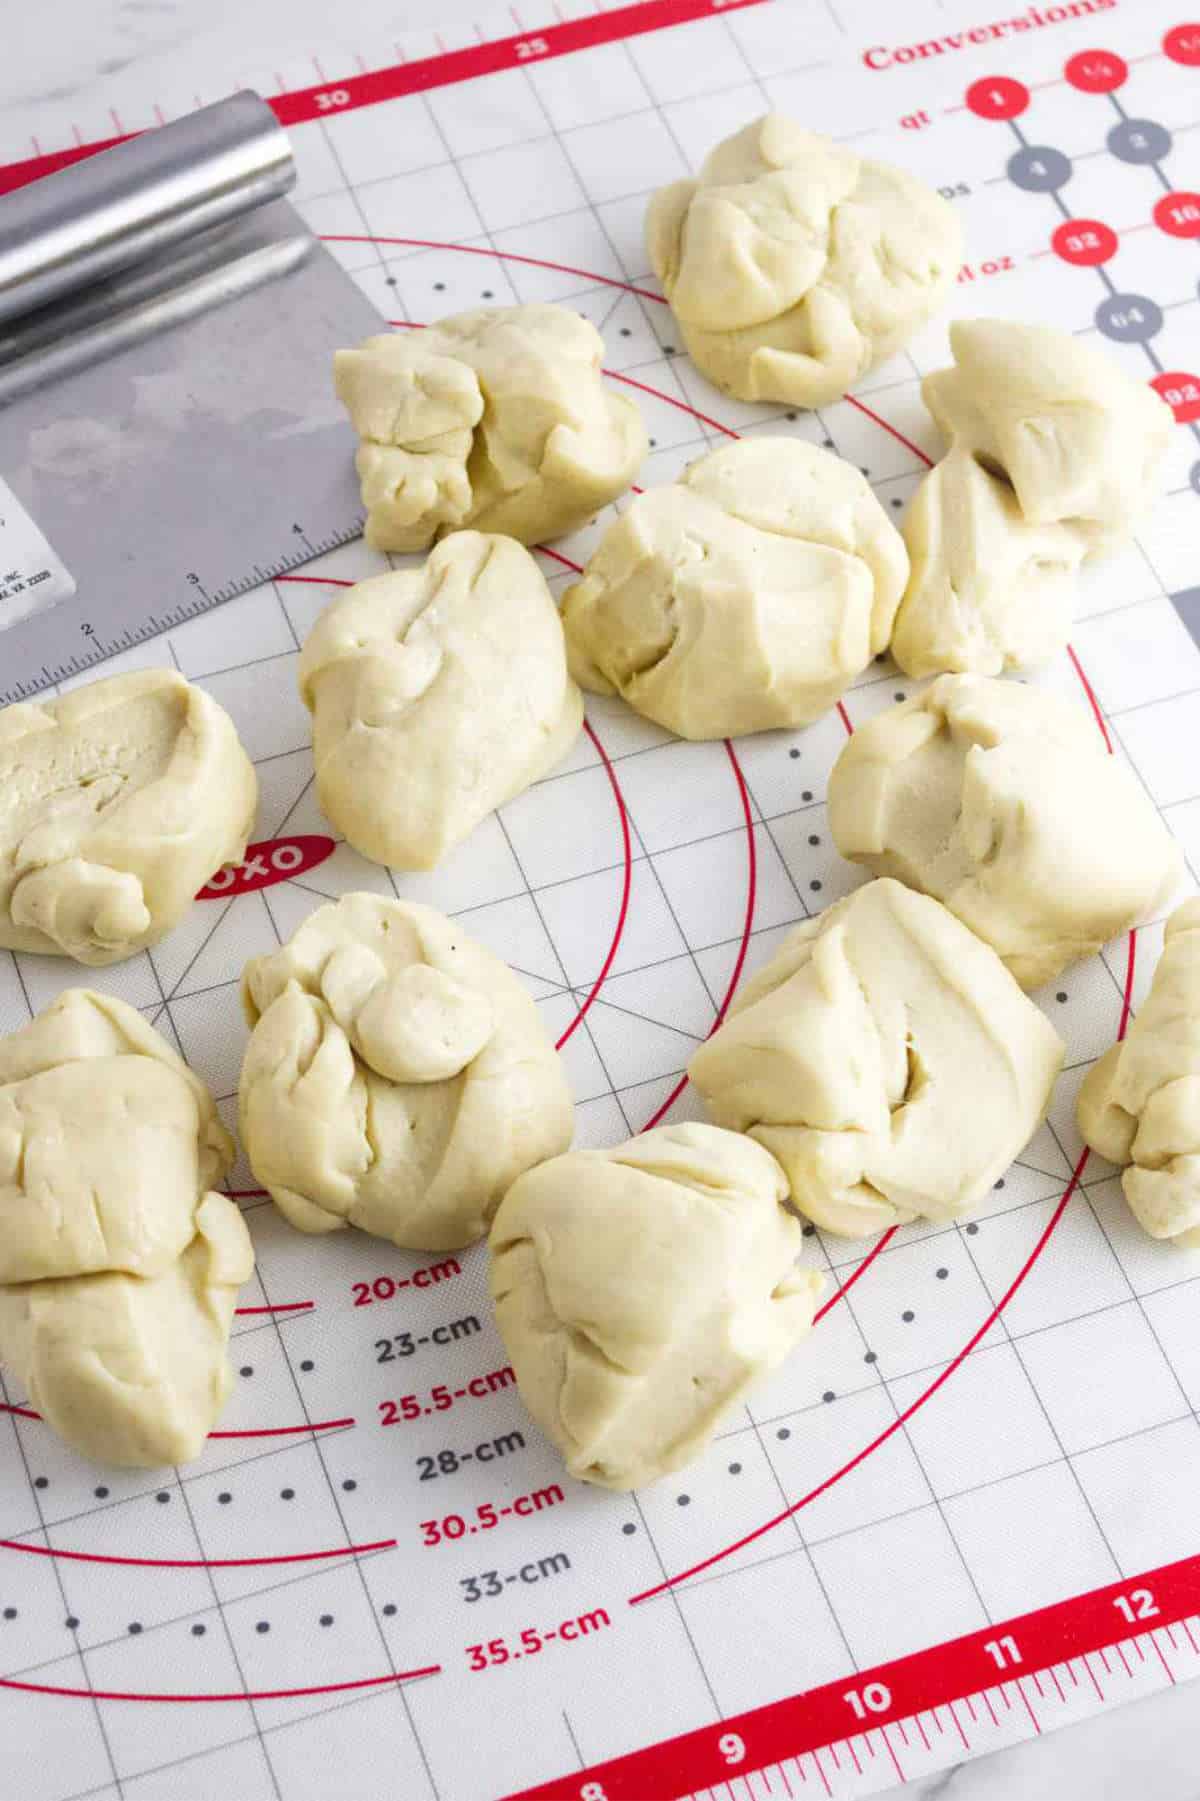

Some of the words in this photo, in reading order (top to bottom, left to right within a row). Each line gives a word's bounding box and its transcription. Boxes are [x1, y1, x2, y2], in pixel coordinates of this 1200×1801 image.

[313, 89, 350, 110] 30
[514, 36, 549, 59] 25
[900, 110, 931, 130] qt
[981, 255, 1015, 276] oz
[1065, 231, 1102, 253] 32
[80, 623, 94, 635] 2
[186, 572, 199, 585] 3
[292, 523, 304, 535] 4
[205, 845, 304, 891] OXO
[351, 1257, 462, 1307] 20-cm
[374, 1312, 482, 1364] 23-cm
[378, 1364, 517, 1427] 25.5-cm
[416, 1427, 526, 1481] 28-cm
[419, 1482, 565, 1547] 30.5-cm
[460, 1550, 572, 1603] 33-cm
[465, 1605, 612, 1671] 35.5-cm
[718, 1733, 746, 1764] 9
[843, 1681, 892, 1719] 10
[983, 1635, 1024, 1669] 11
[1113, 1588, 1160, 1624] 12
